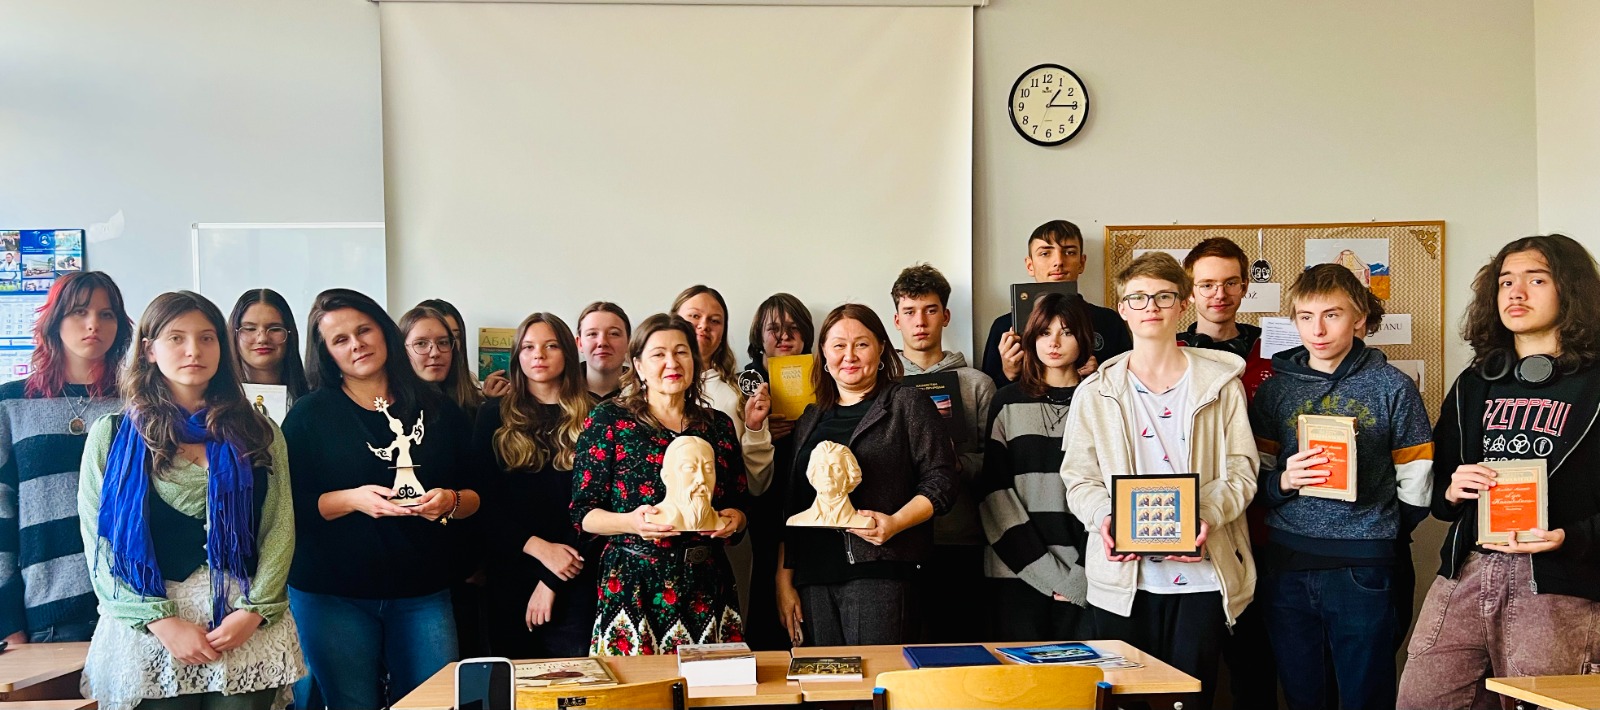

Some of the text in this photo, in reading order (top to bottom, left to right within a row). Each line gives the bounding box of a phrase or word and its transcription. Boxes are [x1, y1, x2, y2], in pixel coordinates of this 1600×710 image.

[1030, 78, 1039, 87] 11
[1042, 74, 1053, 83] 12
[1059, 77, 1063, 87] 1
[1020, 88, 1030, 98] 10
[1067, 87, 1074, 96] 2
[1018, 102, 1024, 111] 9
[1072, 101, 1078, 110] 3
[1022, 115, 1029, 125] 8
[1068, 114, 1074, 123] 4
[1032, 125, 1038, 134] 7
[1059, 124, 1065, 133] 5
[1045, 129, 1052, 138] 6
[1379, 323, 1403, 331] TANU
